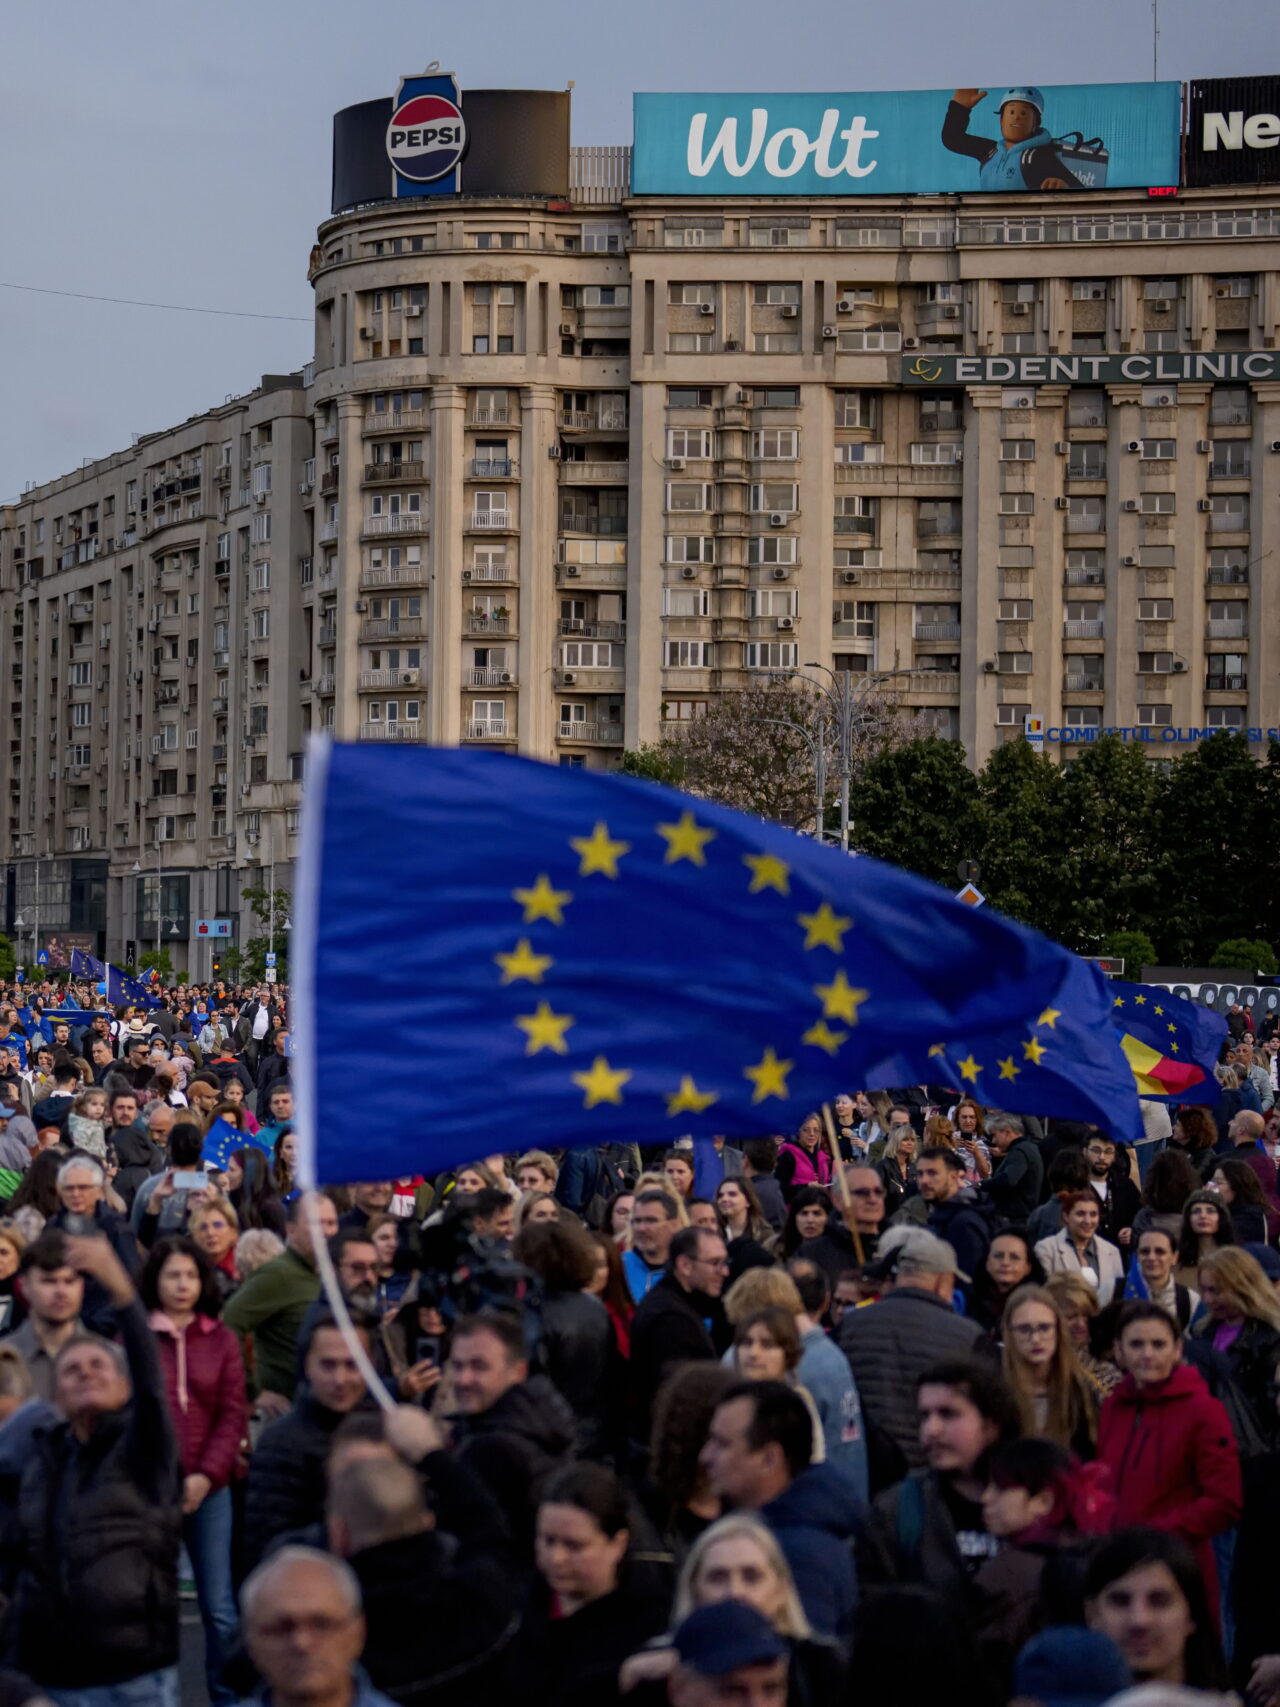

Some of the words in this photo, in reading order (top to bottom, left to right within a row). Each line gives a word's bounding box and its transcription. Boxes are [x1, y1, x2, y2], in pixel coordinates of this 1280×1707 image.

[391, 126, 461, 149] PEPSI
[687, 108, 880, 178] Wolt
[1203, 111, 1280, 152] Ne
[955, 356, 1110, 382] EDENT
[1120, 353, 1275, 380] CLINIC
[1046, 727, 1157, 743] COMITUL
[1161, 727, 1239, 743] OLIMP
[1267, 727, 1280, 743] S
